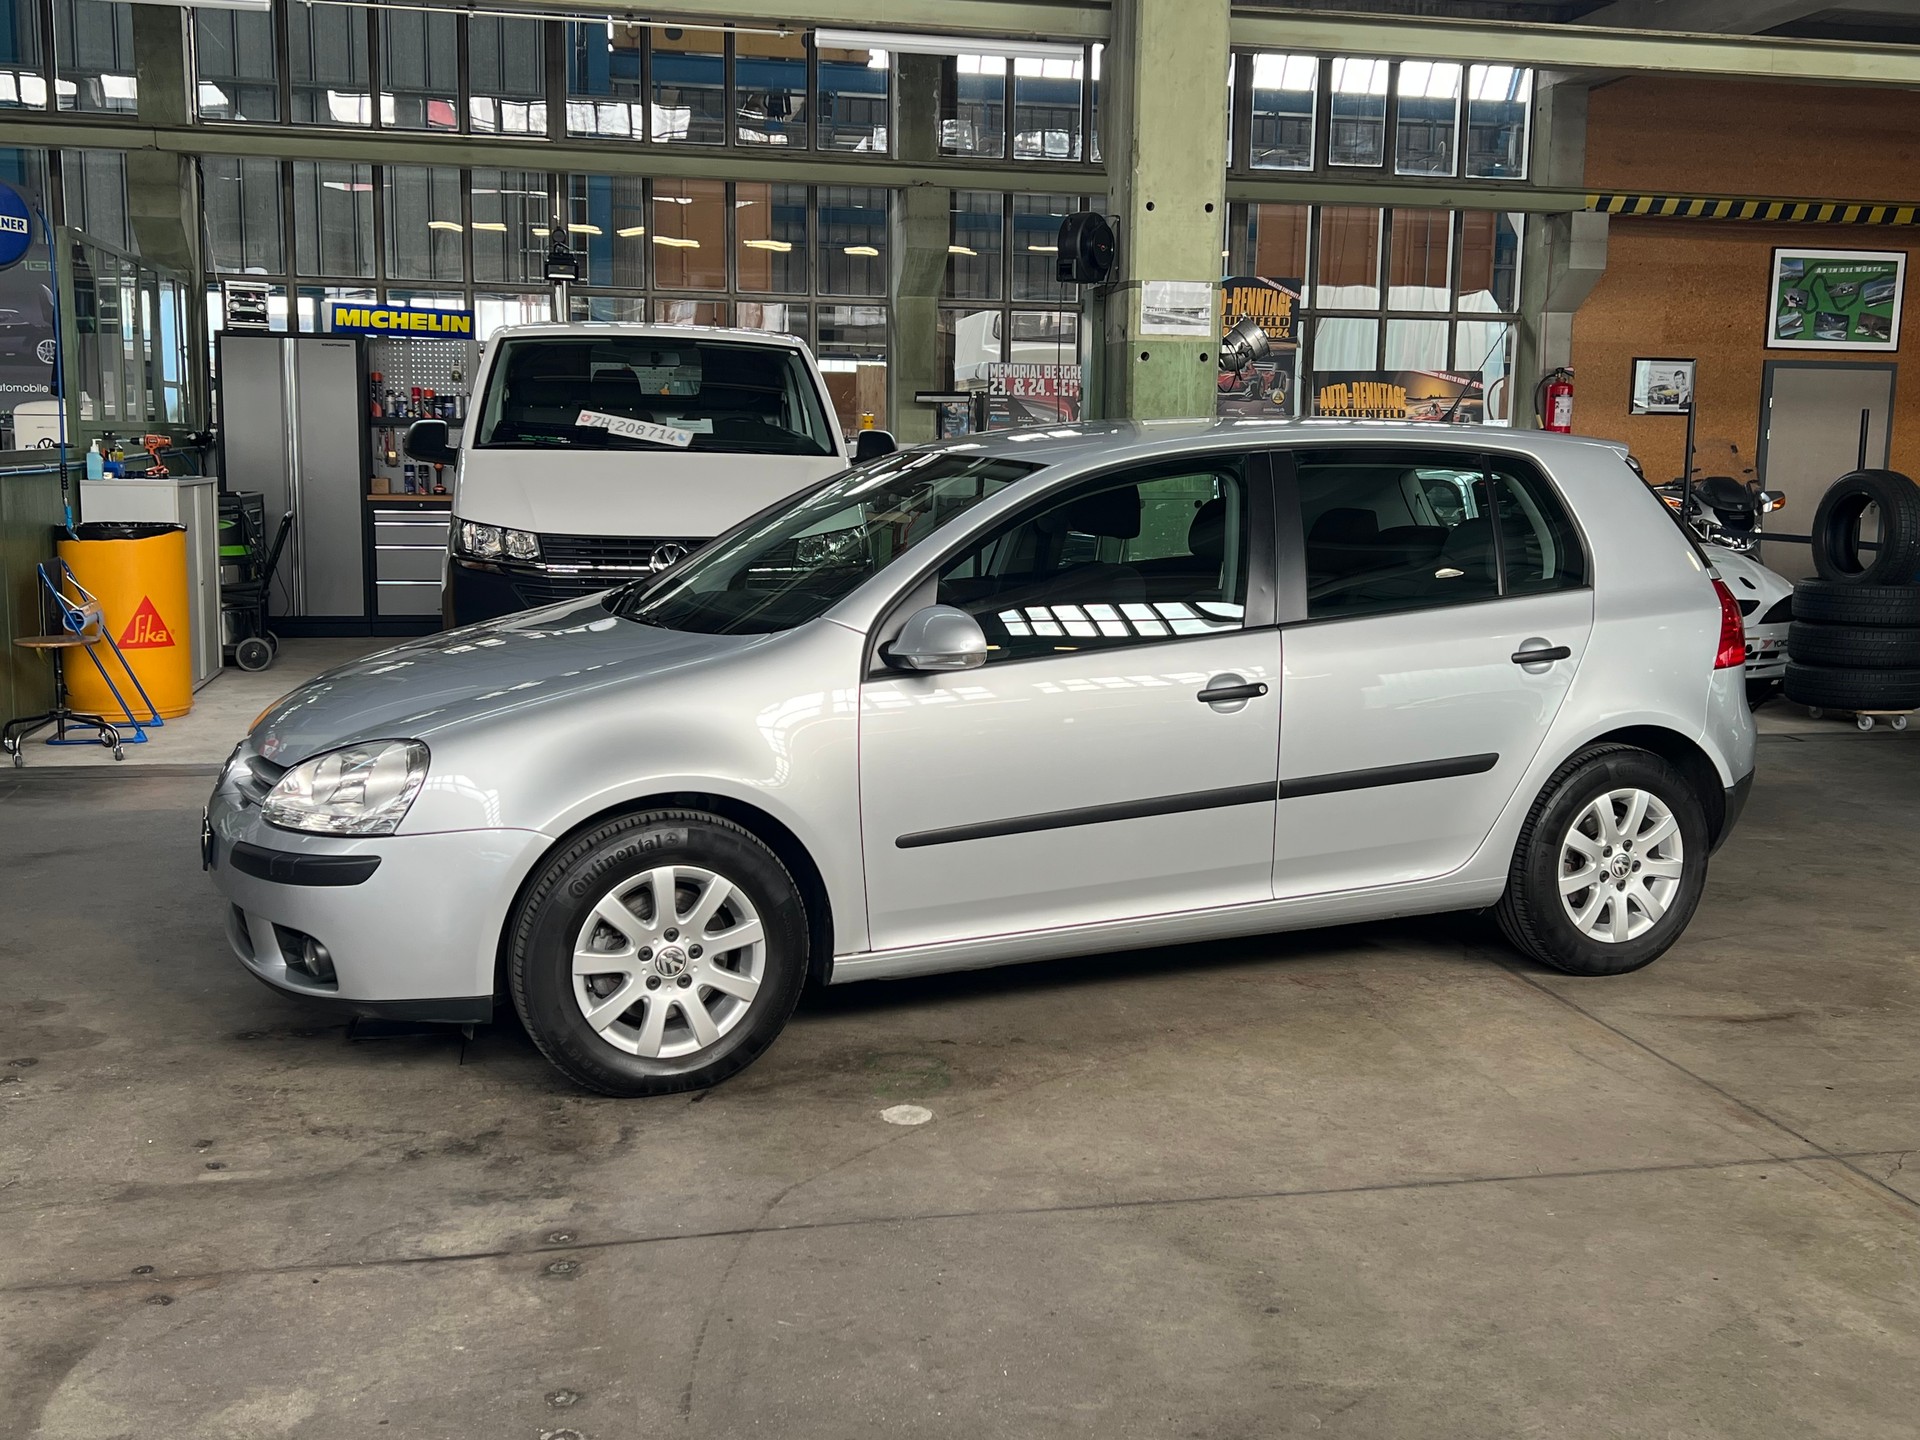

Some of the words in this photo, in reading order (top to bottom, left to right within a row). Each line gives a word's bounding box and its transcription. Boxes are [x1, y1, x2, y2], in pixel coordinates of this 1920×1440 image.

[335, 308, 470, 333] MICHELIN
[989, 363, 1042, 378] MEMORIAL
[989, 378, 1011, 396] 23.
[1013, 378, 1025, 396] &
[1028, 379, 1050, 396] 24.
[1053, 380, 1081, 397] SEP
[1320, 381, 1407, 409] AUTO-RENNTAGE
[1321, 409, 1406, 419] FRAUENFELD
[126, 614, 168, 644] Sika
[568, 834, 663, 899] Continental
